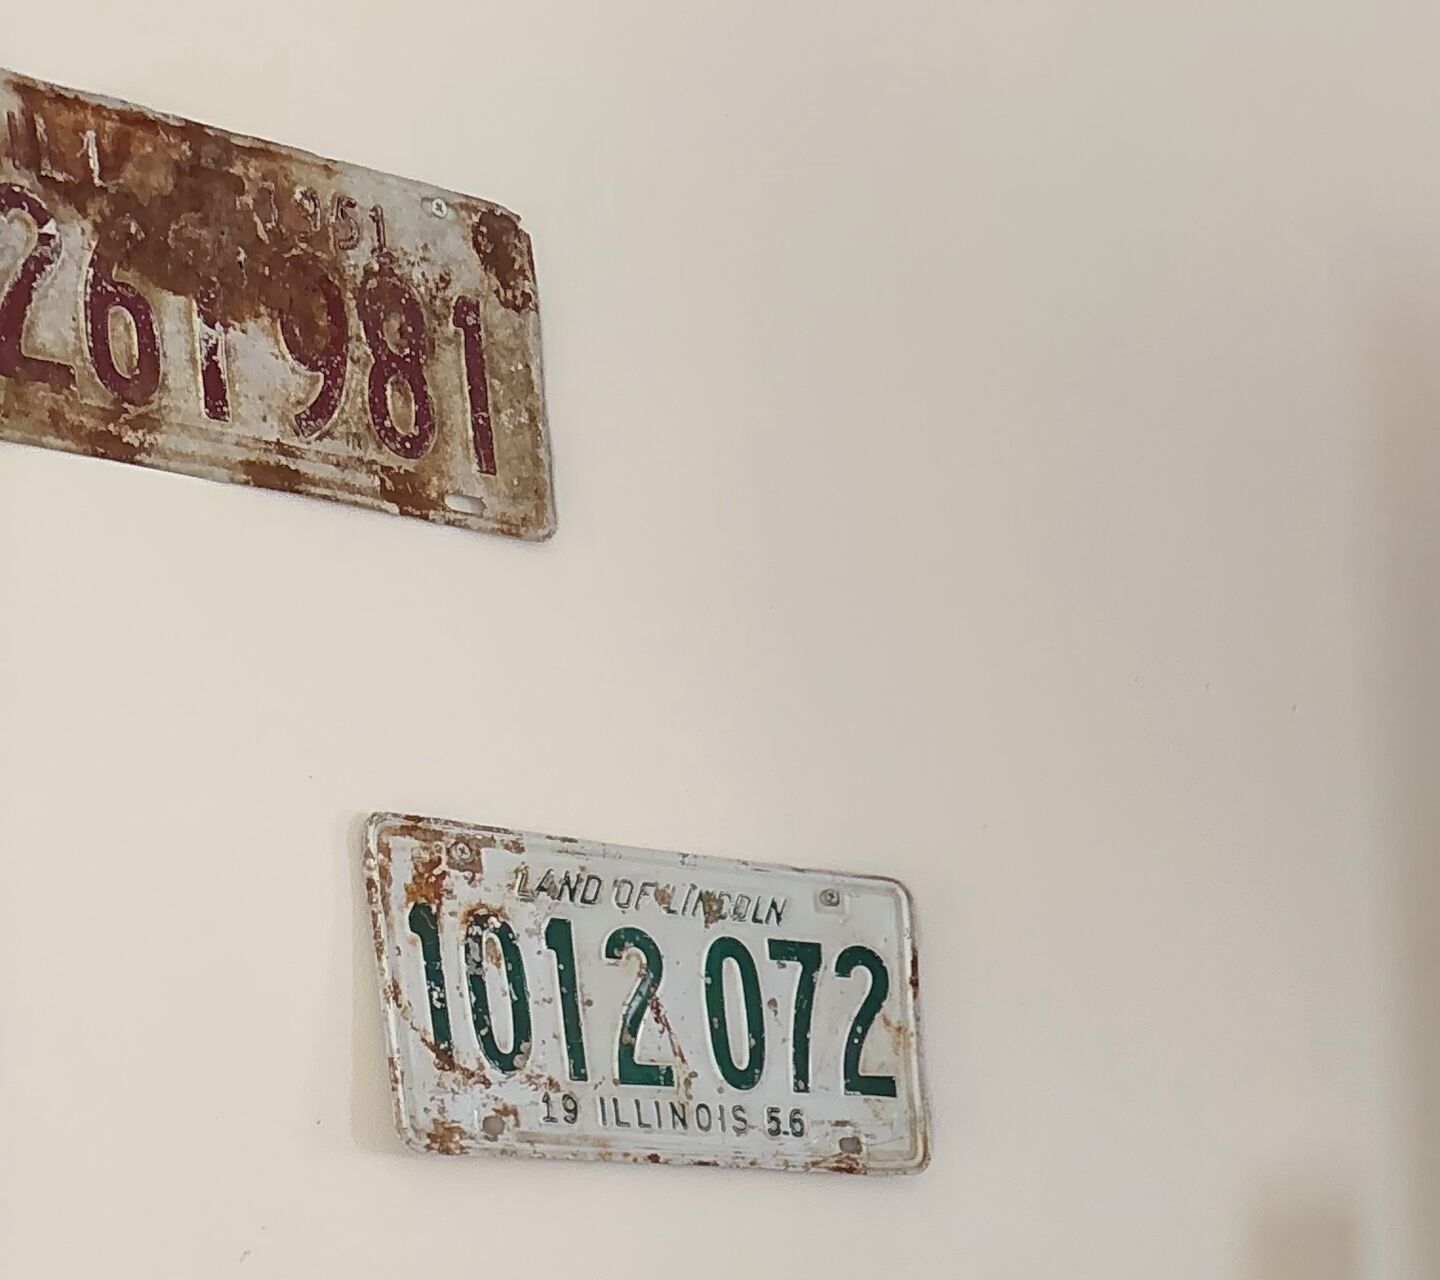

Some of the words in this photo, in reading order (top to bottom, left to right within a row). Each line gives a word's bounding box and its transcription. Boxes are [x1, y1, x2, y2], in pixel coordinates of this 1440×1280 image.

[517, 867, 602, 906] LAND
[612, 876, 657, 911] OF
[406, 901, 676, 1088] 1012
[703, 929, 898, 1098] 072
[541, 1090, 579, 1125] 19
[598, 1096, 749, 1137] ILLINOIS
